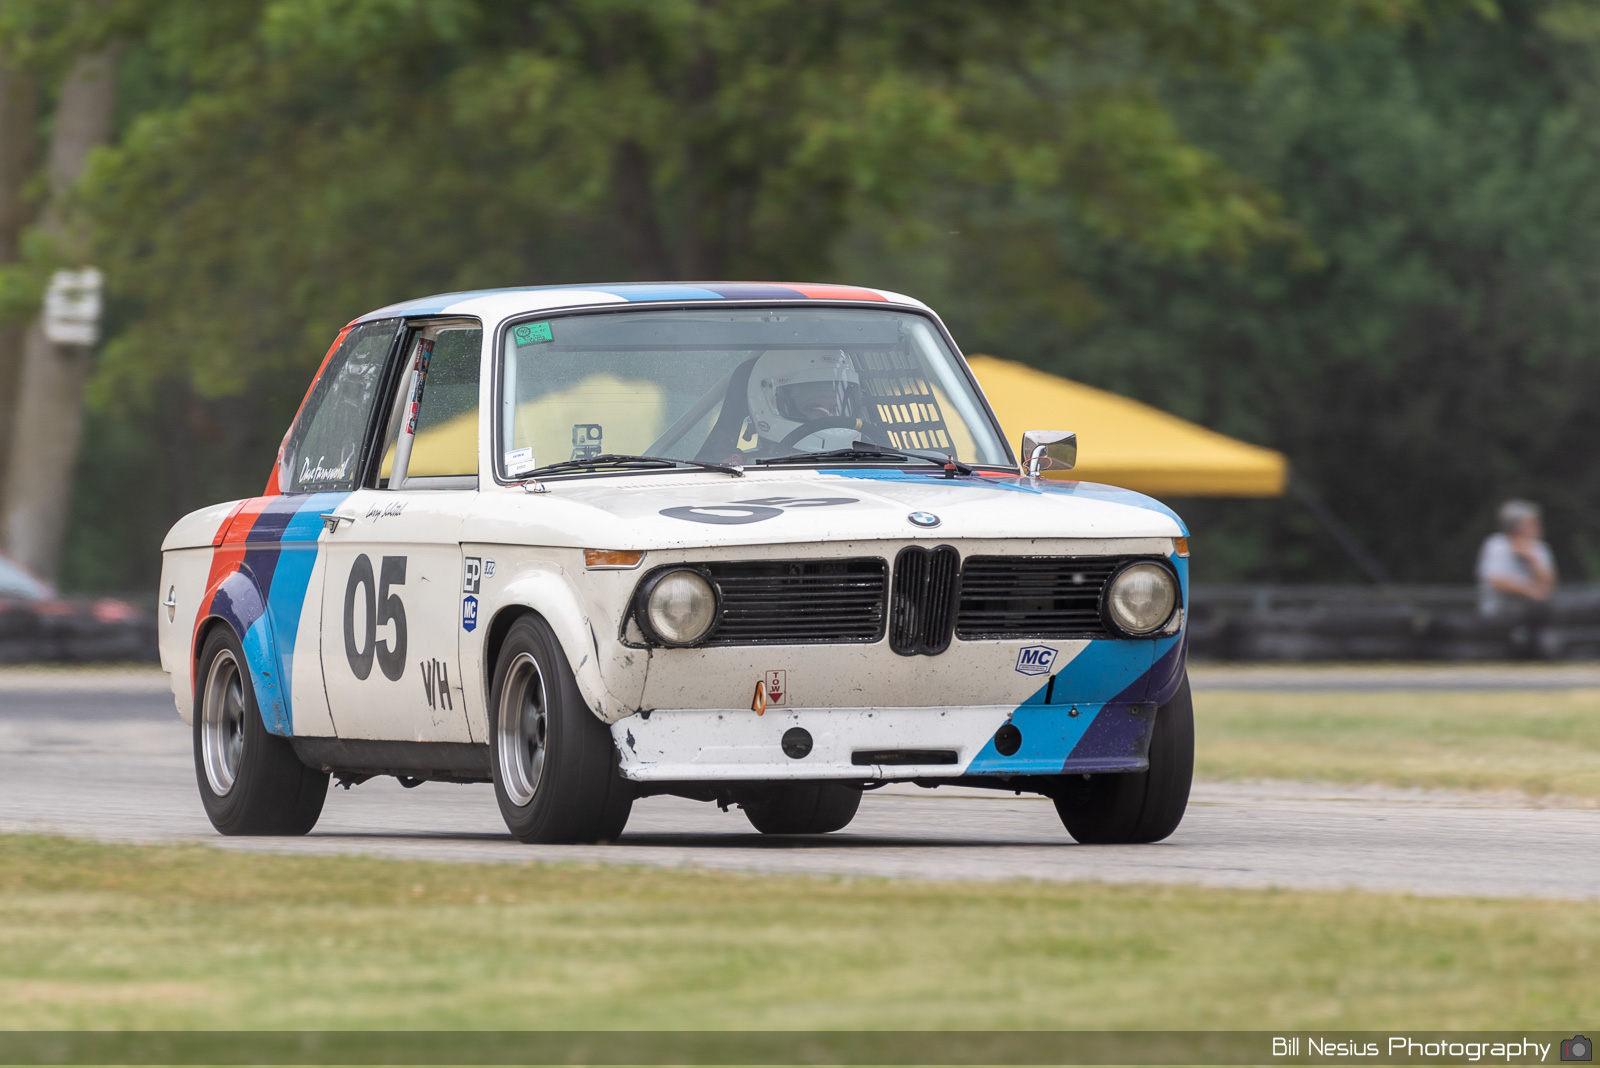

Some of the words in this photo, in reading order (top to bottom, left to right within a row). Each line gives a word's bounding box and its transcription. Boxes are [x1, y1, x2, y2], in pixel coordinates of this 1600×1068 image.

[658, 496, 860, 525] 05
[464, 558, 481, 592] EP
[343, 553, 408, 682] 05
[464, 601, 476, 619] MC
[1021, 650, 1052, 665] MC
[771, 671, 780, 692] TOW
